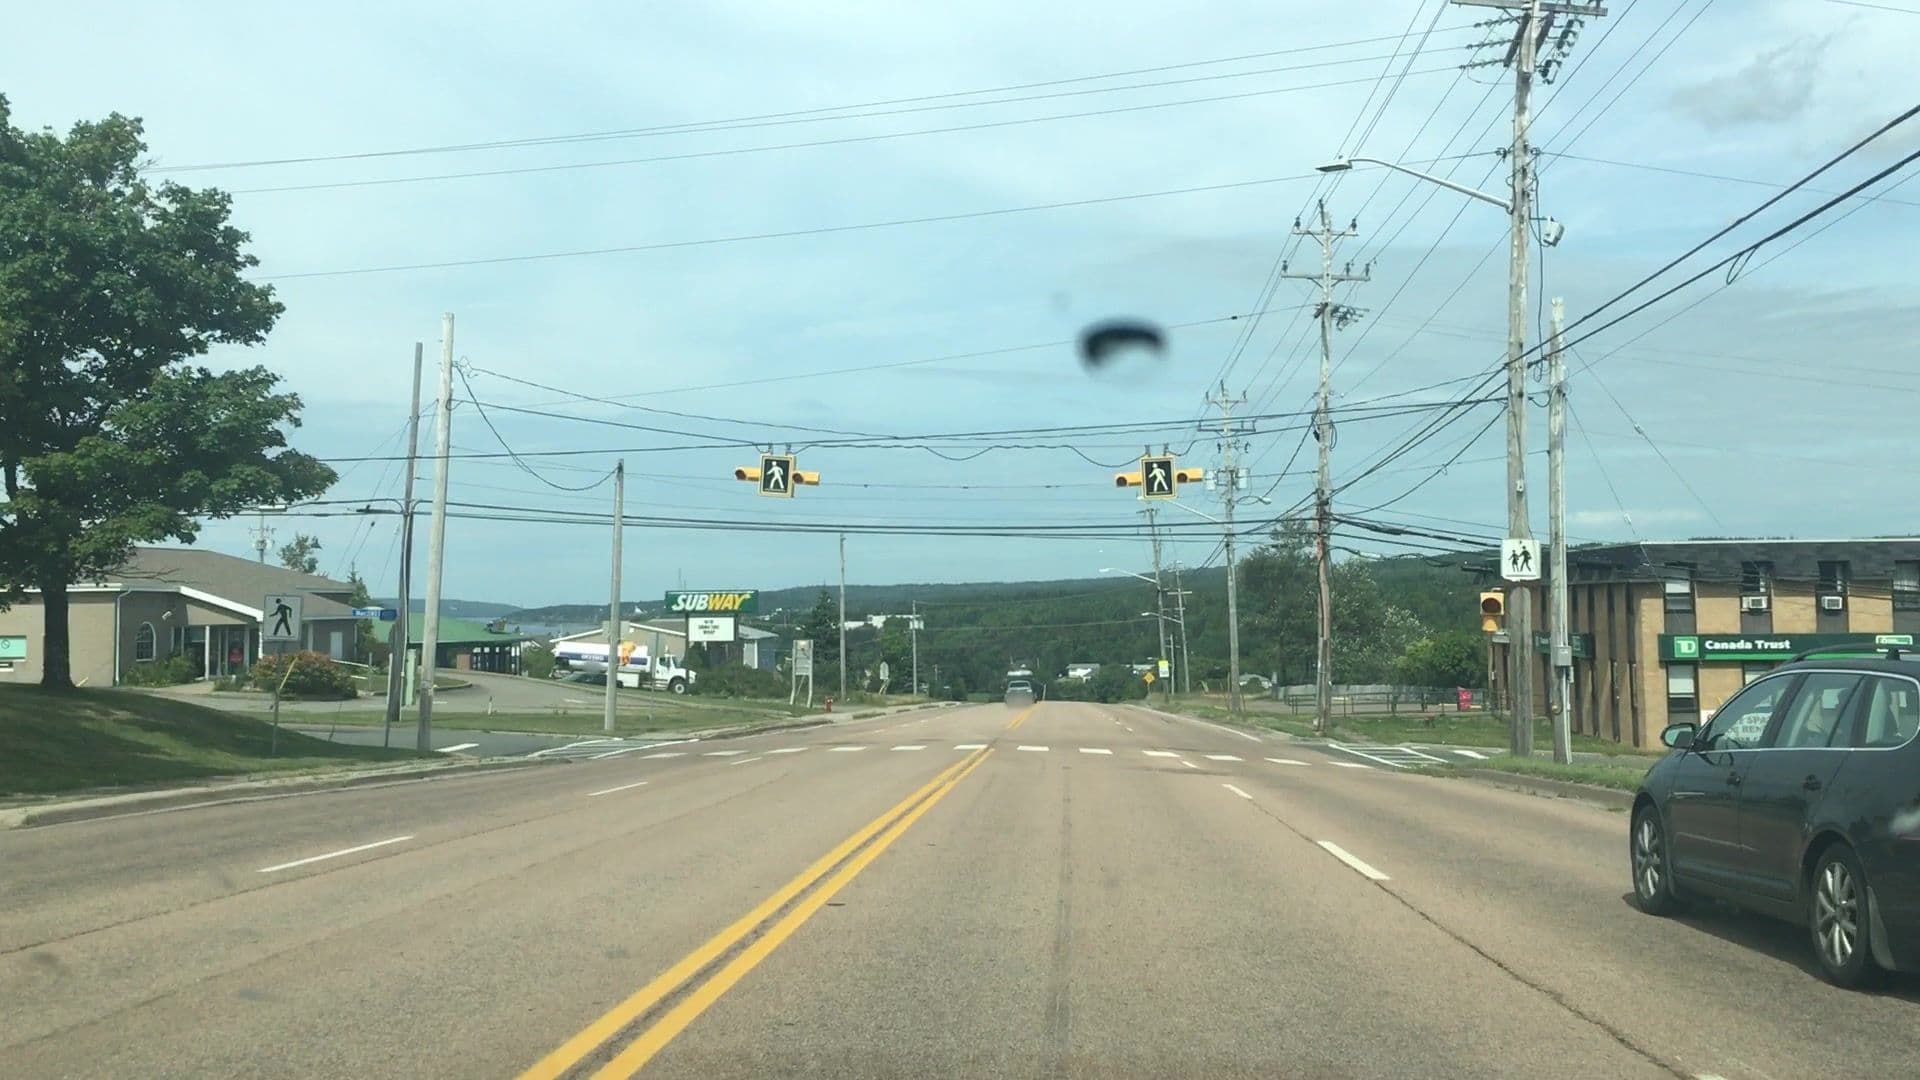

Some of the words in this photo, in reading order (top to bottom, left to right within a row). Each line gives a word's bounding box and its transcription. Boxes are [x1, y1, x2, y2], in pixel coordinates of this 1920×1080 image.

[671, 593, 751, 611] SUBWAY
[1676, 640, 1696, 654] TD
[1705, 640, 1753, 650] Canada
[1754, 640, 1791, 650] Trust
